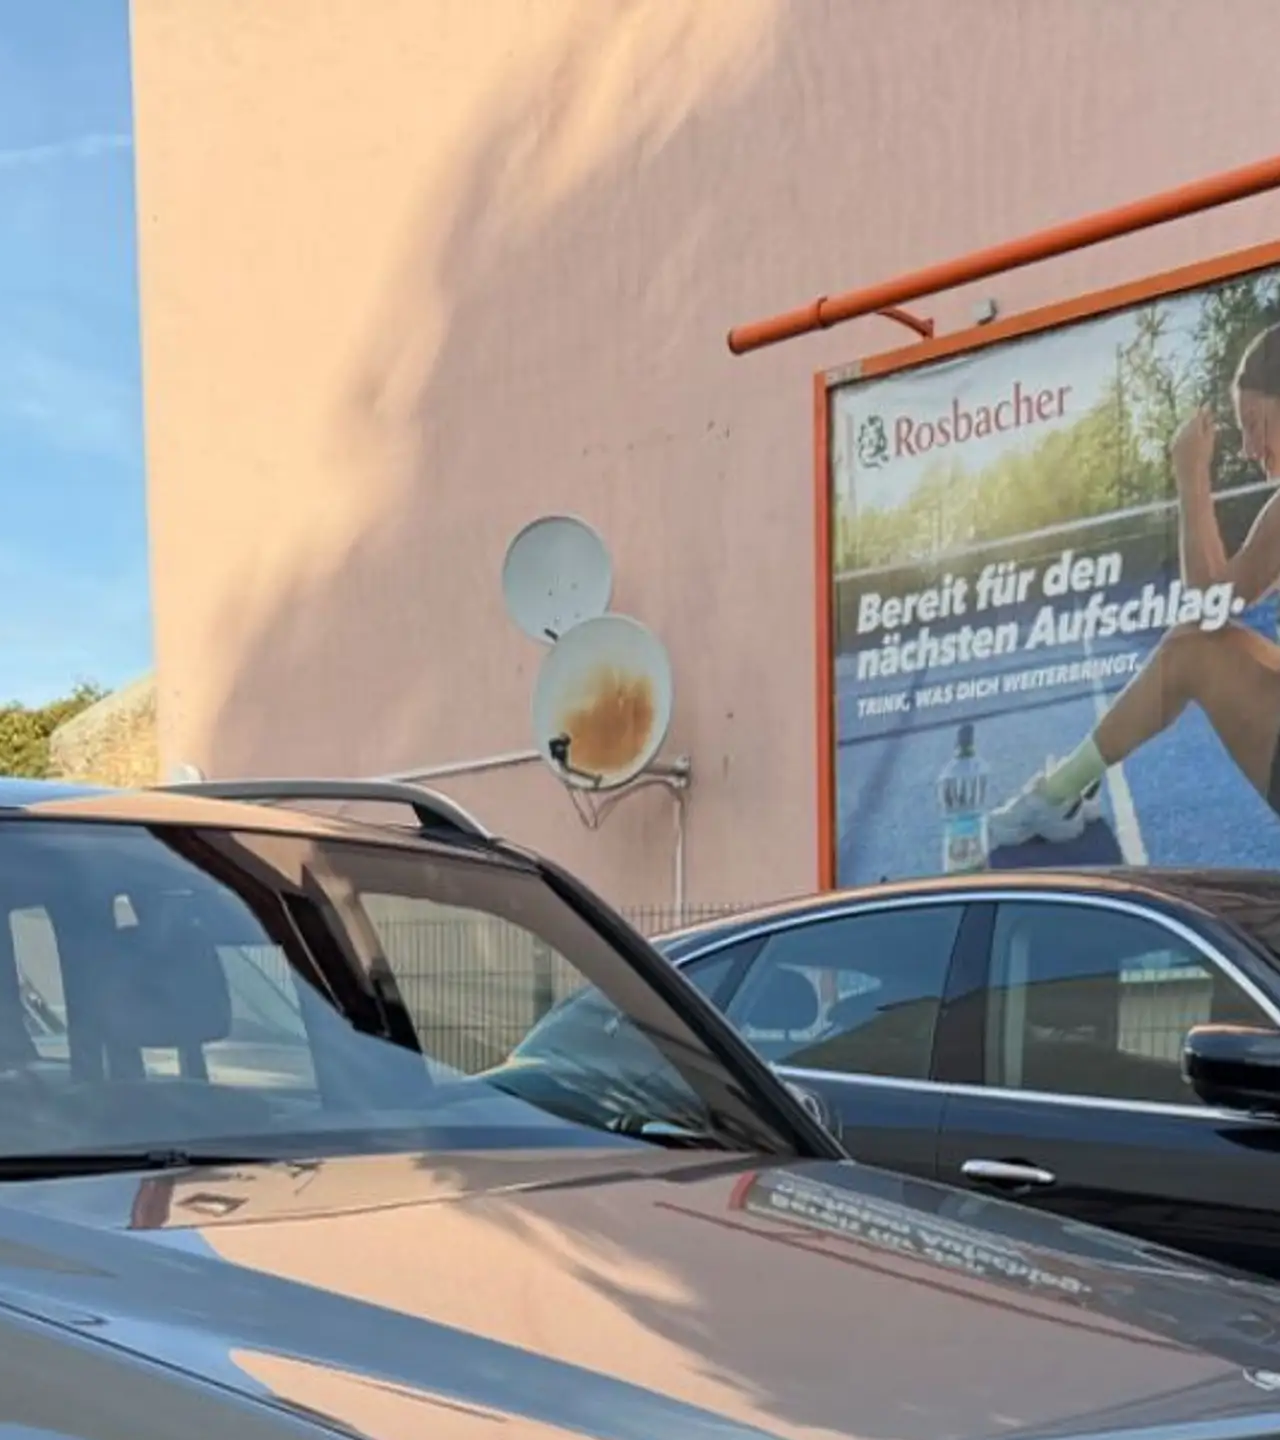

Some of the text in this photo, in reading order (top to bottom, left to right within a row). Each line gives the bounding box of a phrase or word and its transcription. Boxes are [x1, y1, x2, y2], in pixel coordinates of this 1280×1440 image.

[894, 381, 1073, 458] Rosbacher
[857, 549, 1122, 634] Bereit für den
[857, 581, 1246, 680] nächsten Aufschlag.
[857, 692, 910, 718] TRINK,
[915, 684, 953, 708] WAS
[956, 675, 999, 701] DICH
